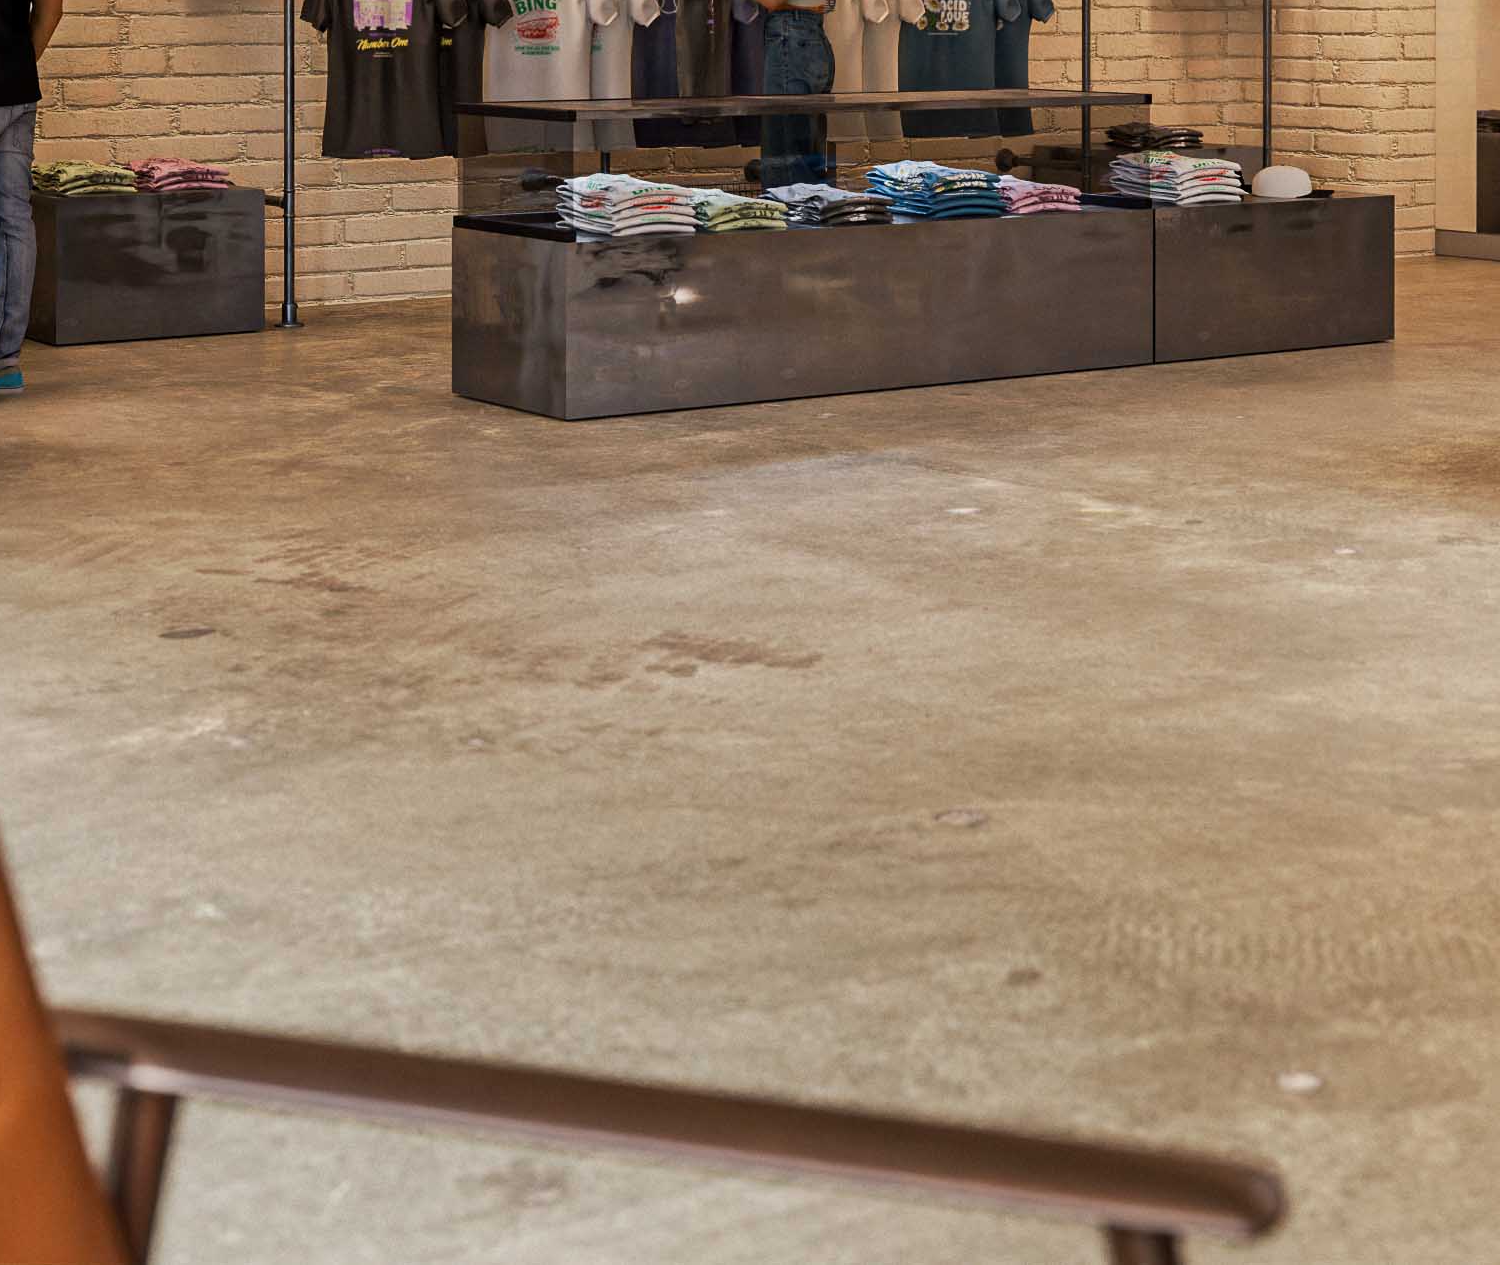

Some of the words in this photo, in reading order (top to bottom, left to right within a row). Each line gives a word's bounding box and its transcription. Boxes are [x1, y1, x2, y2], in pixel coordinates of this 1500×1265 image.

[940, 0, 967, 11] ACID
[356, 38, 389, 51] Number
[390, 37, 409, 48] One
